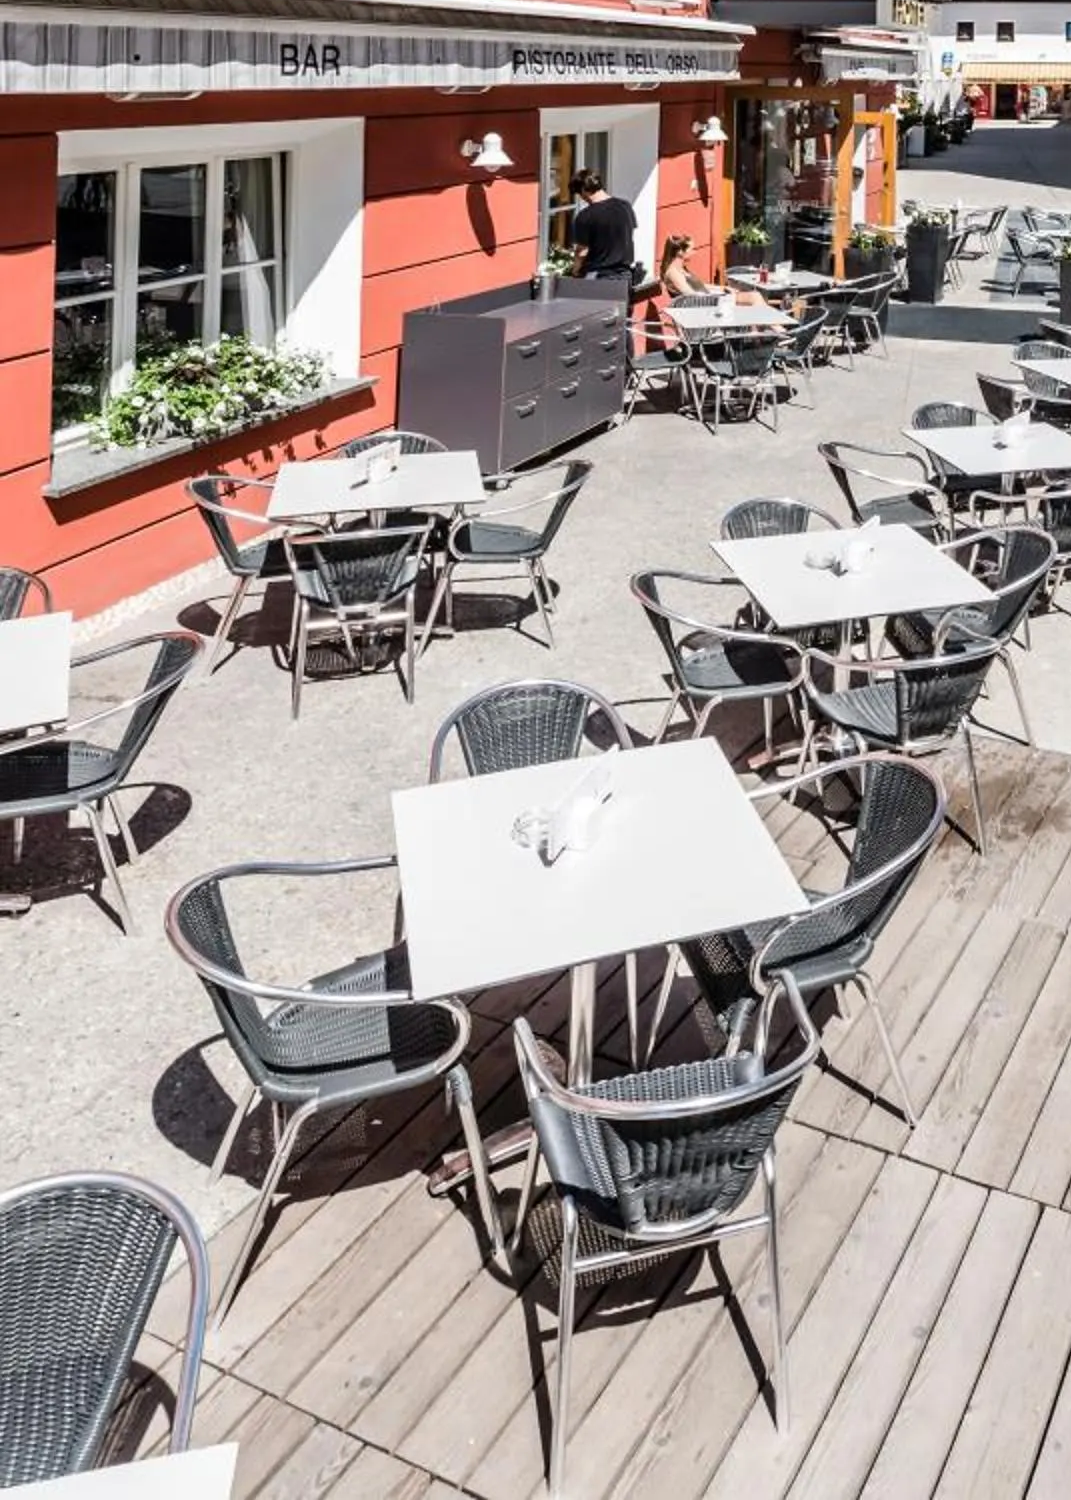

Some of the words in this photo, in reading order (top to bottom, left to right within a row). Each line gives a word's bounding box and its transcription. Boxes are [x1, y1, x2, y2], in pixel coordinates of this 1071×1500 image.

[281, 43, 341, 77] BAR
[512, 49, 616, 75] RISTORANTE
[625, 53, 659, 75] DELL'
[666, 54, 699, 75] ORSO
